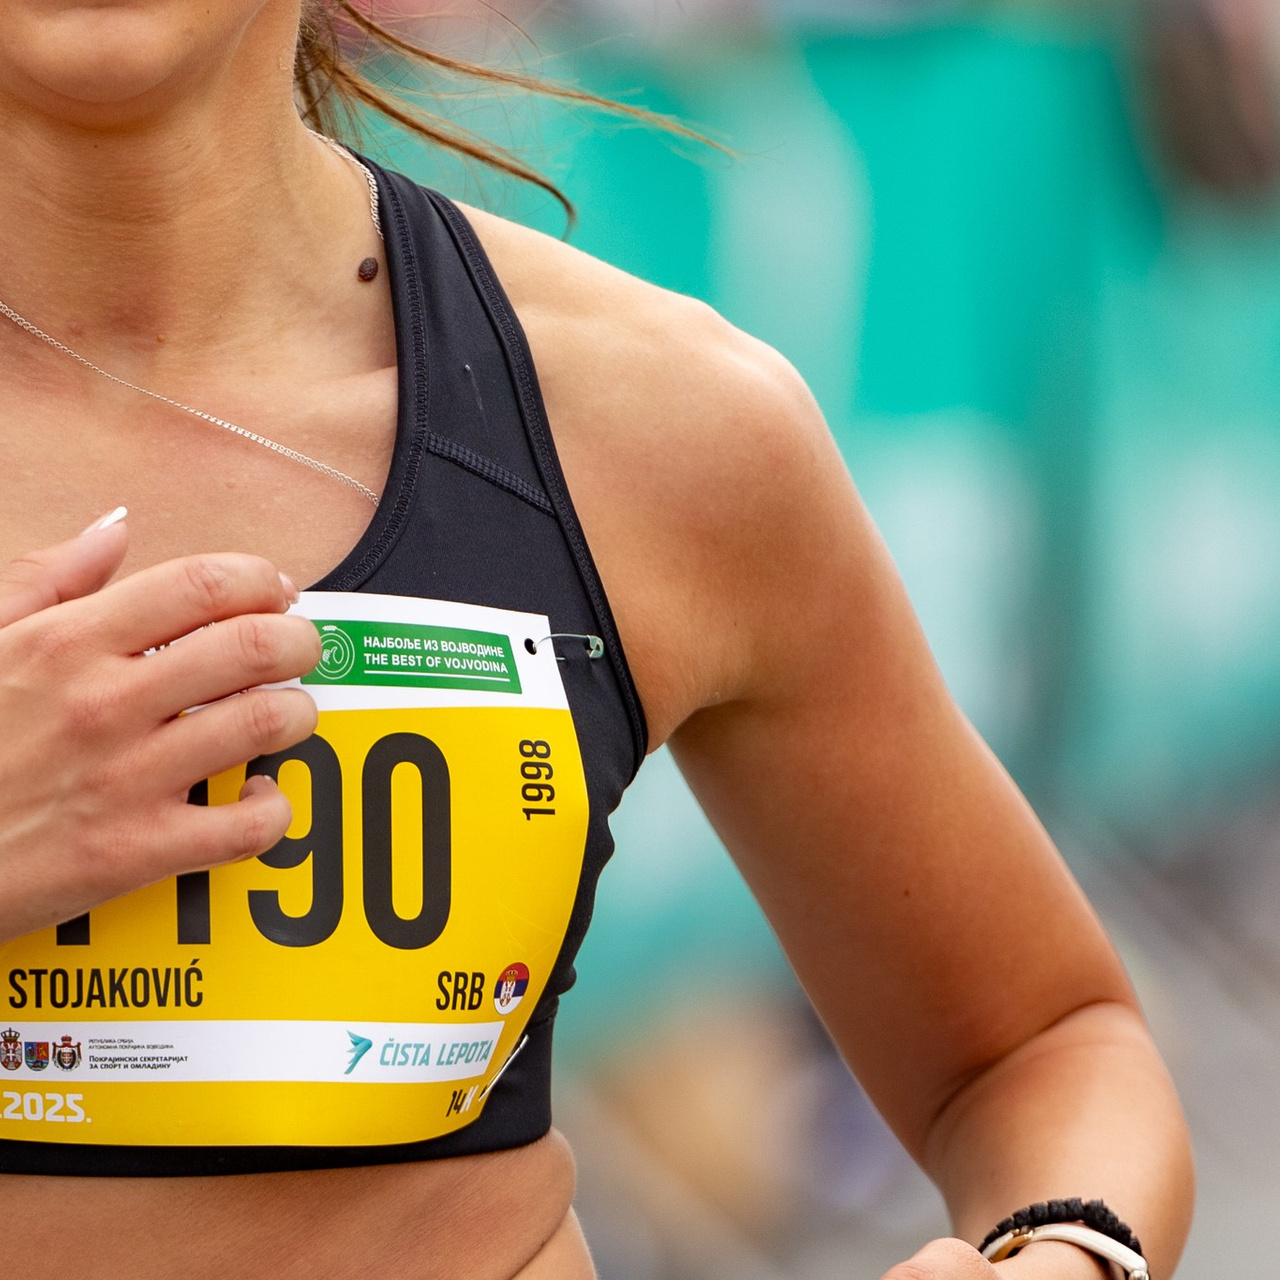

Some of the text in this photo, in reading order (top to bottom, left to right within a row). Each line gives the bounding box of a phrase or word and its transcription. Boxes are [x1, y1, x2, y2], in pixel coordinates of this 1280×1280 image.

[363, 636, 505, 658] НАЈБОЉЕ ИЗ ВОЈВОДИНЕ
[364, 653, 509, 673] THE BEST OF VOJVODINA
[519, 738, 556, 822] 1998
[56, 731, 452, 951] 90
[8, 958, 204, 1009] STOJAKOVIĆ
[435, 970, 484, 1011] SRB
[379, 1037, 494, 1067] ČISTA LEPOTA
